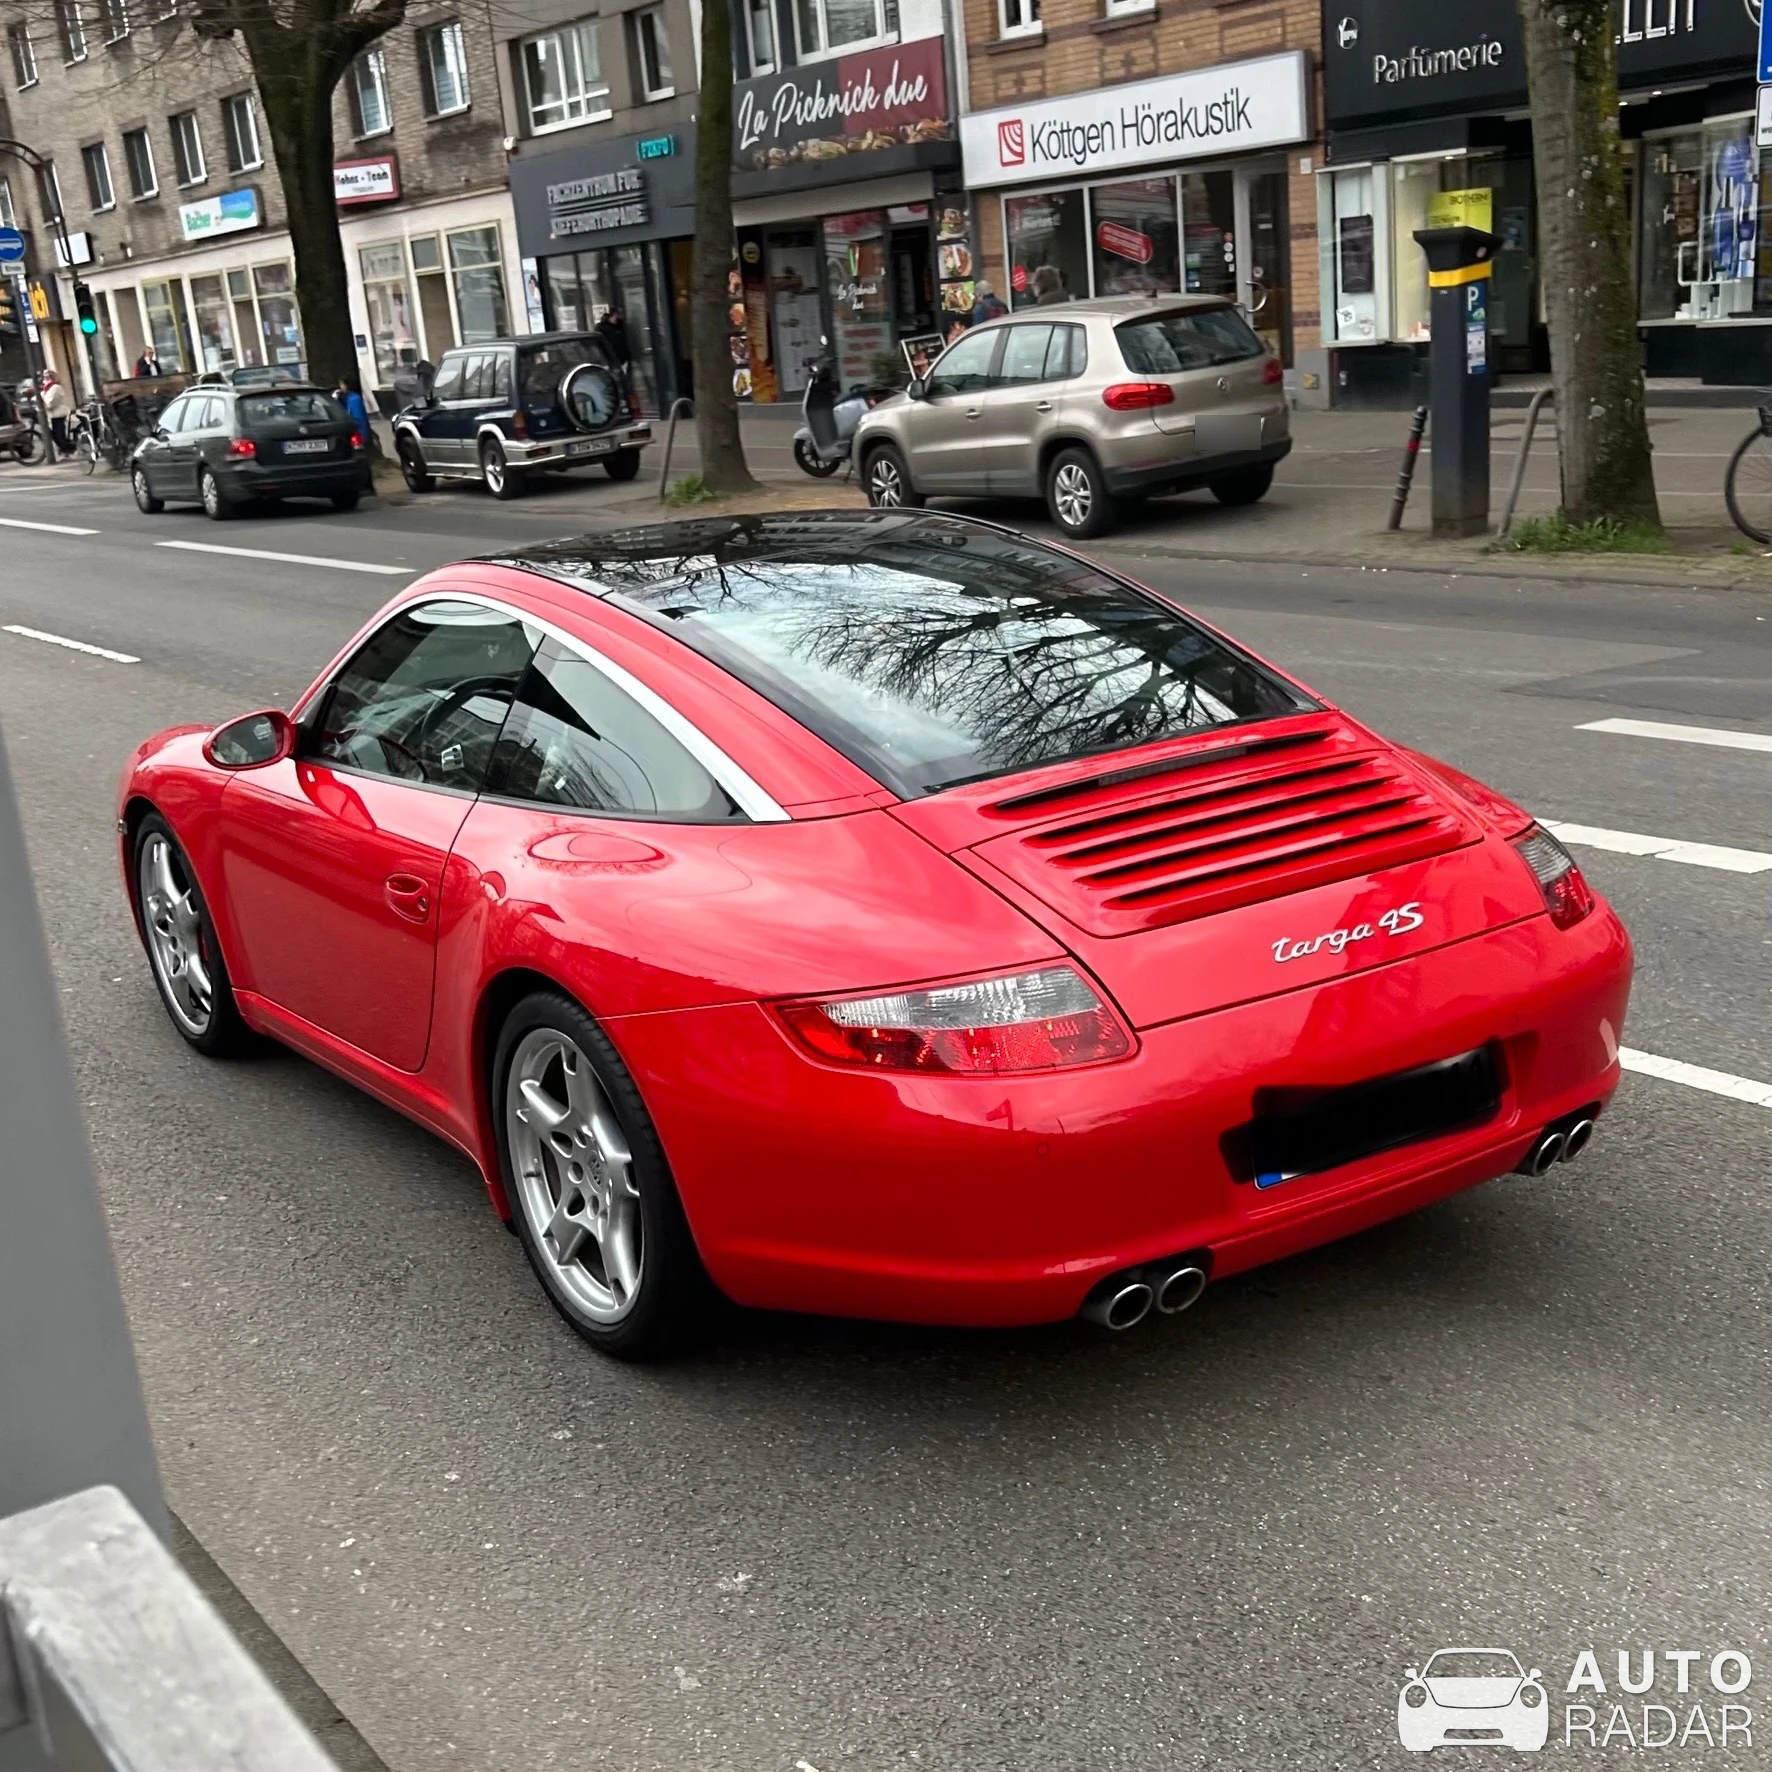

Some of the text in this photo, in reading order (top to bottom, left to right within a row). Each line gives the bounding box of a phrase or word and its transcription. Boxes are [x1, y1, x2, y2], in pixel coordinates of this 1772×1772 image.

[1374, 33, 1502, 84] Parfümerie
[738, 59, 928, 150] La Picknick due
[1031, 87, 1252, 166] Köttgen Hörakustik
[1467, 285, 1480, 312] P
[1378, 901, 1425, 936] 4S
